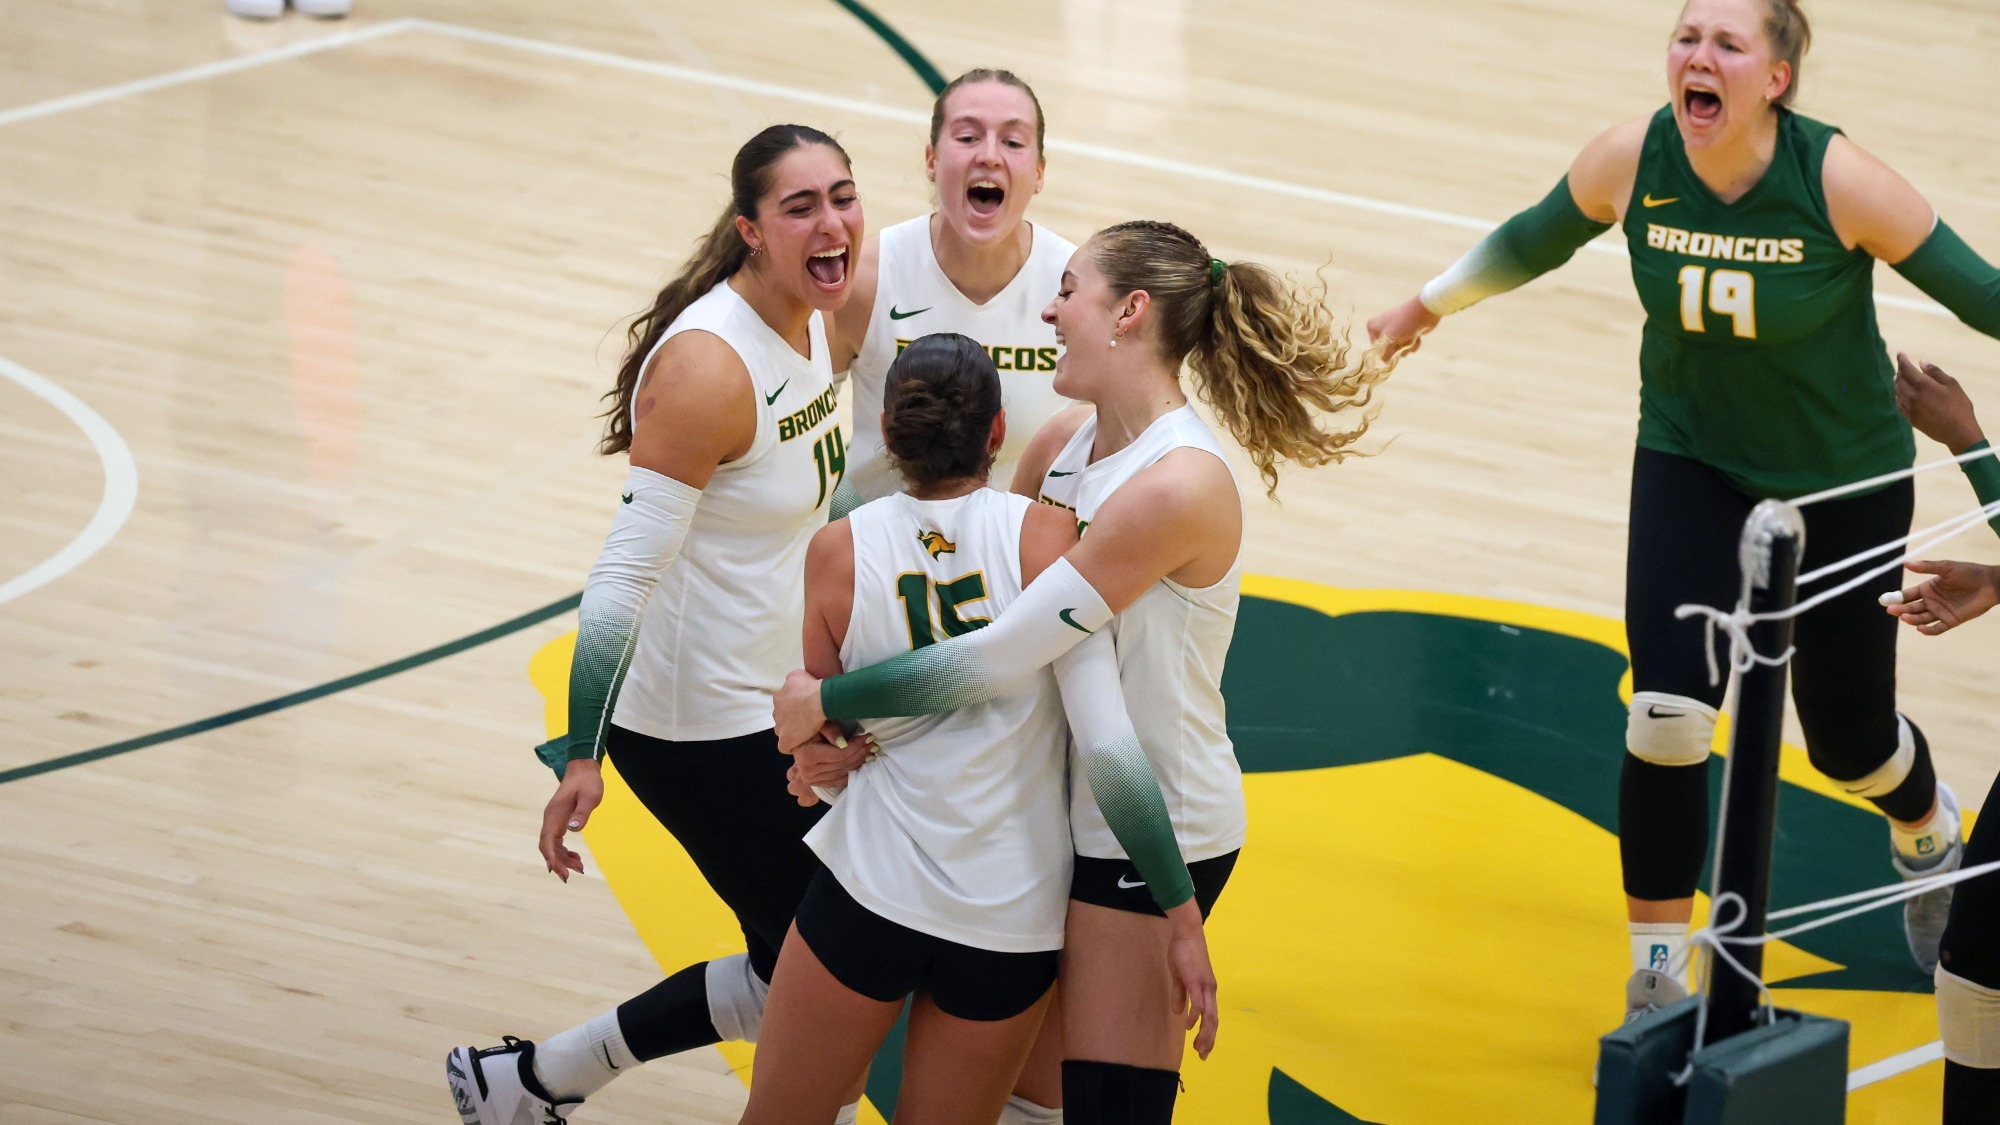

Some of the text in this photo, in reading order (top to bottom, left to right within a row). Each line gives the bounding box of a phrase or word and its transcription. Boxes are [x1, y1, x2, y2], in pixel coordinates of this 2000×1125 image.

[1647, 222, 1804, 263] BRONCOS
[1677, 264, 1757, 339] 19
[813, 422, 846, 511] 14
